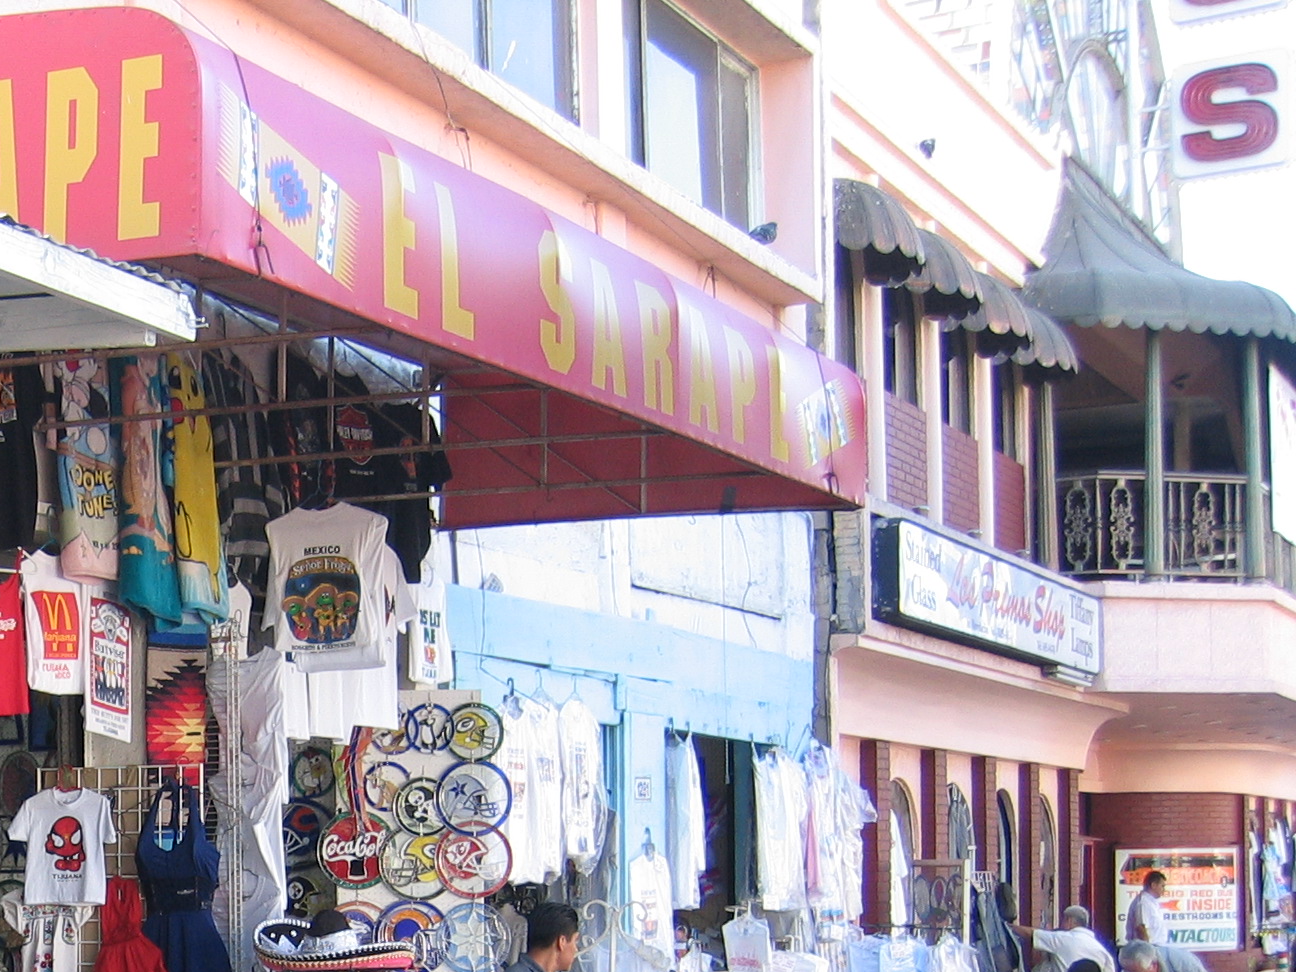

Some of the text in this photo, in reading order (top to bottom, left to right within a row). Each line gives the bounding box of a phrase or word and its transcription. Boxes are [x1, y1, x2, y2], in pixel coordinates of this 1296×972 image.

[1180, 62, 1279, 163] S
[377, 150, 791, 464] EL SARAPE
[304, 545, 341, 555] MEXICO
[293, 560, 322, 575] Señor
[912, 573, 937, 612] Glass
[1032, 585, 1066, 653] Shop
[322, 833, 355, 862] Coca
[1190, 889, 1214, 898] RED
[1186, 898, 1233, 912] INSIDE
[1163, 912, 1224, 921] RESTROOMS
[1166, 928, 1236, 944] NTACTOURS
